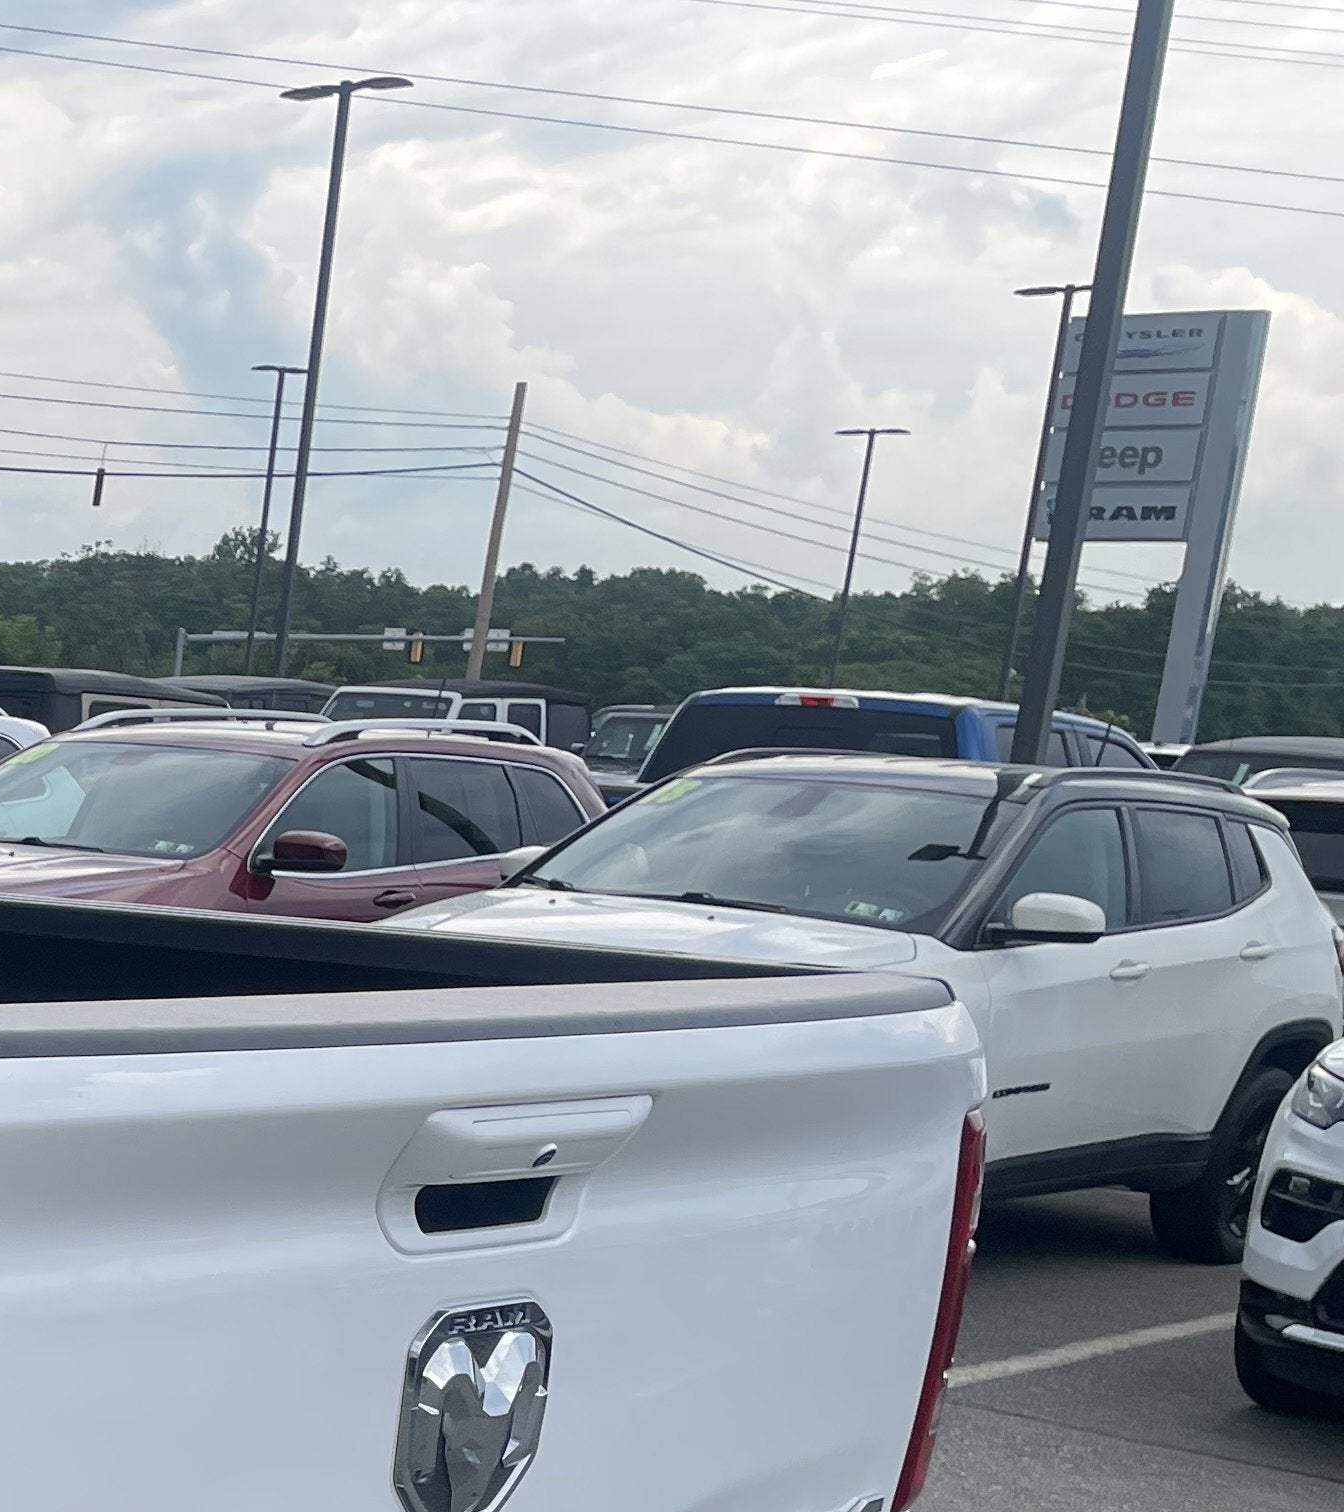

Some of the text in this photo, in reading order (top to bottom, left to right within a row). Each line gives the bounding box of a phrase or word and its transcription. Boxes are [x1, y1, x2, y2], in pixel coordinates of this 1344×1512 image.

[1074, 328, 1204, 342] CYSLER
[1098, 446, 1163, 475] eep
[1088, 505, 1177, 521] RAM
[448, 1307, 532, 1335] RAM
